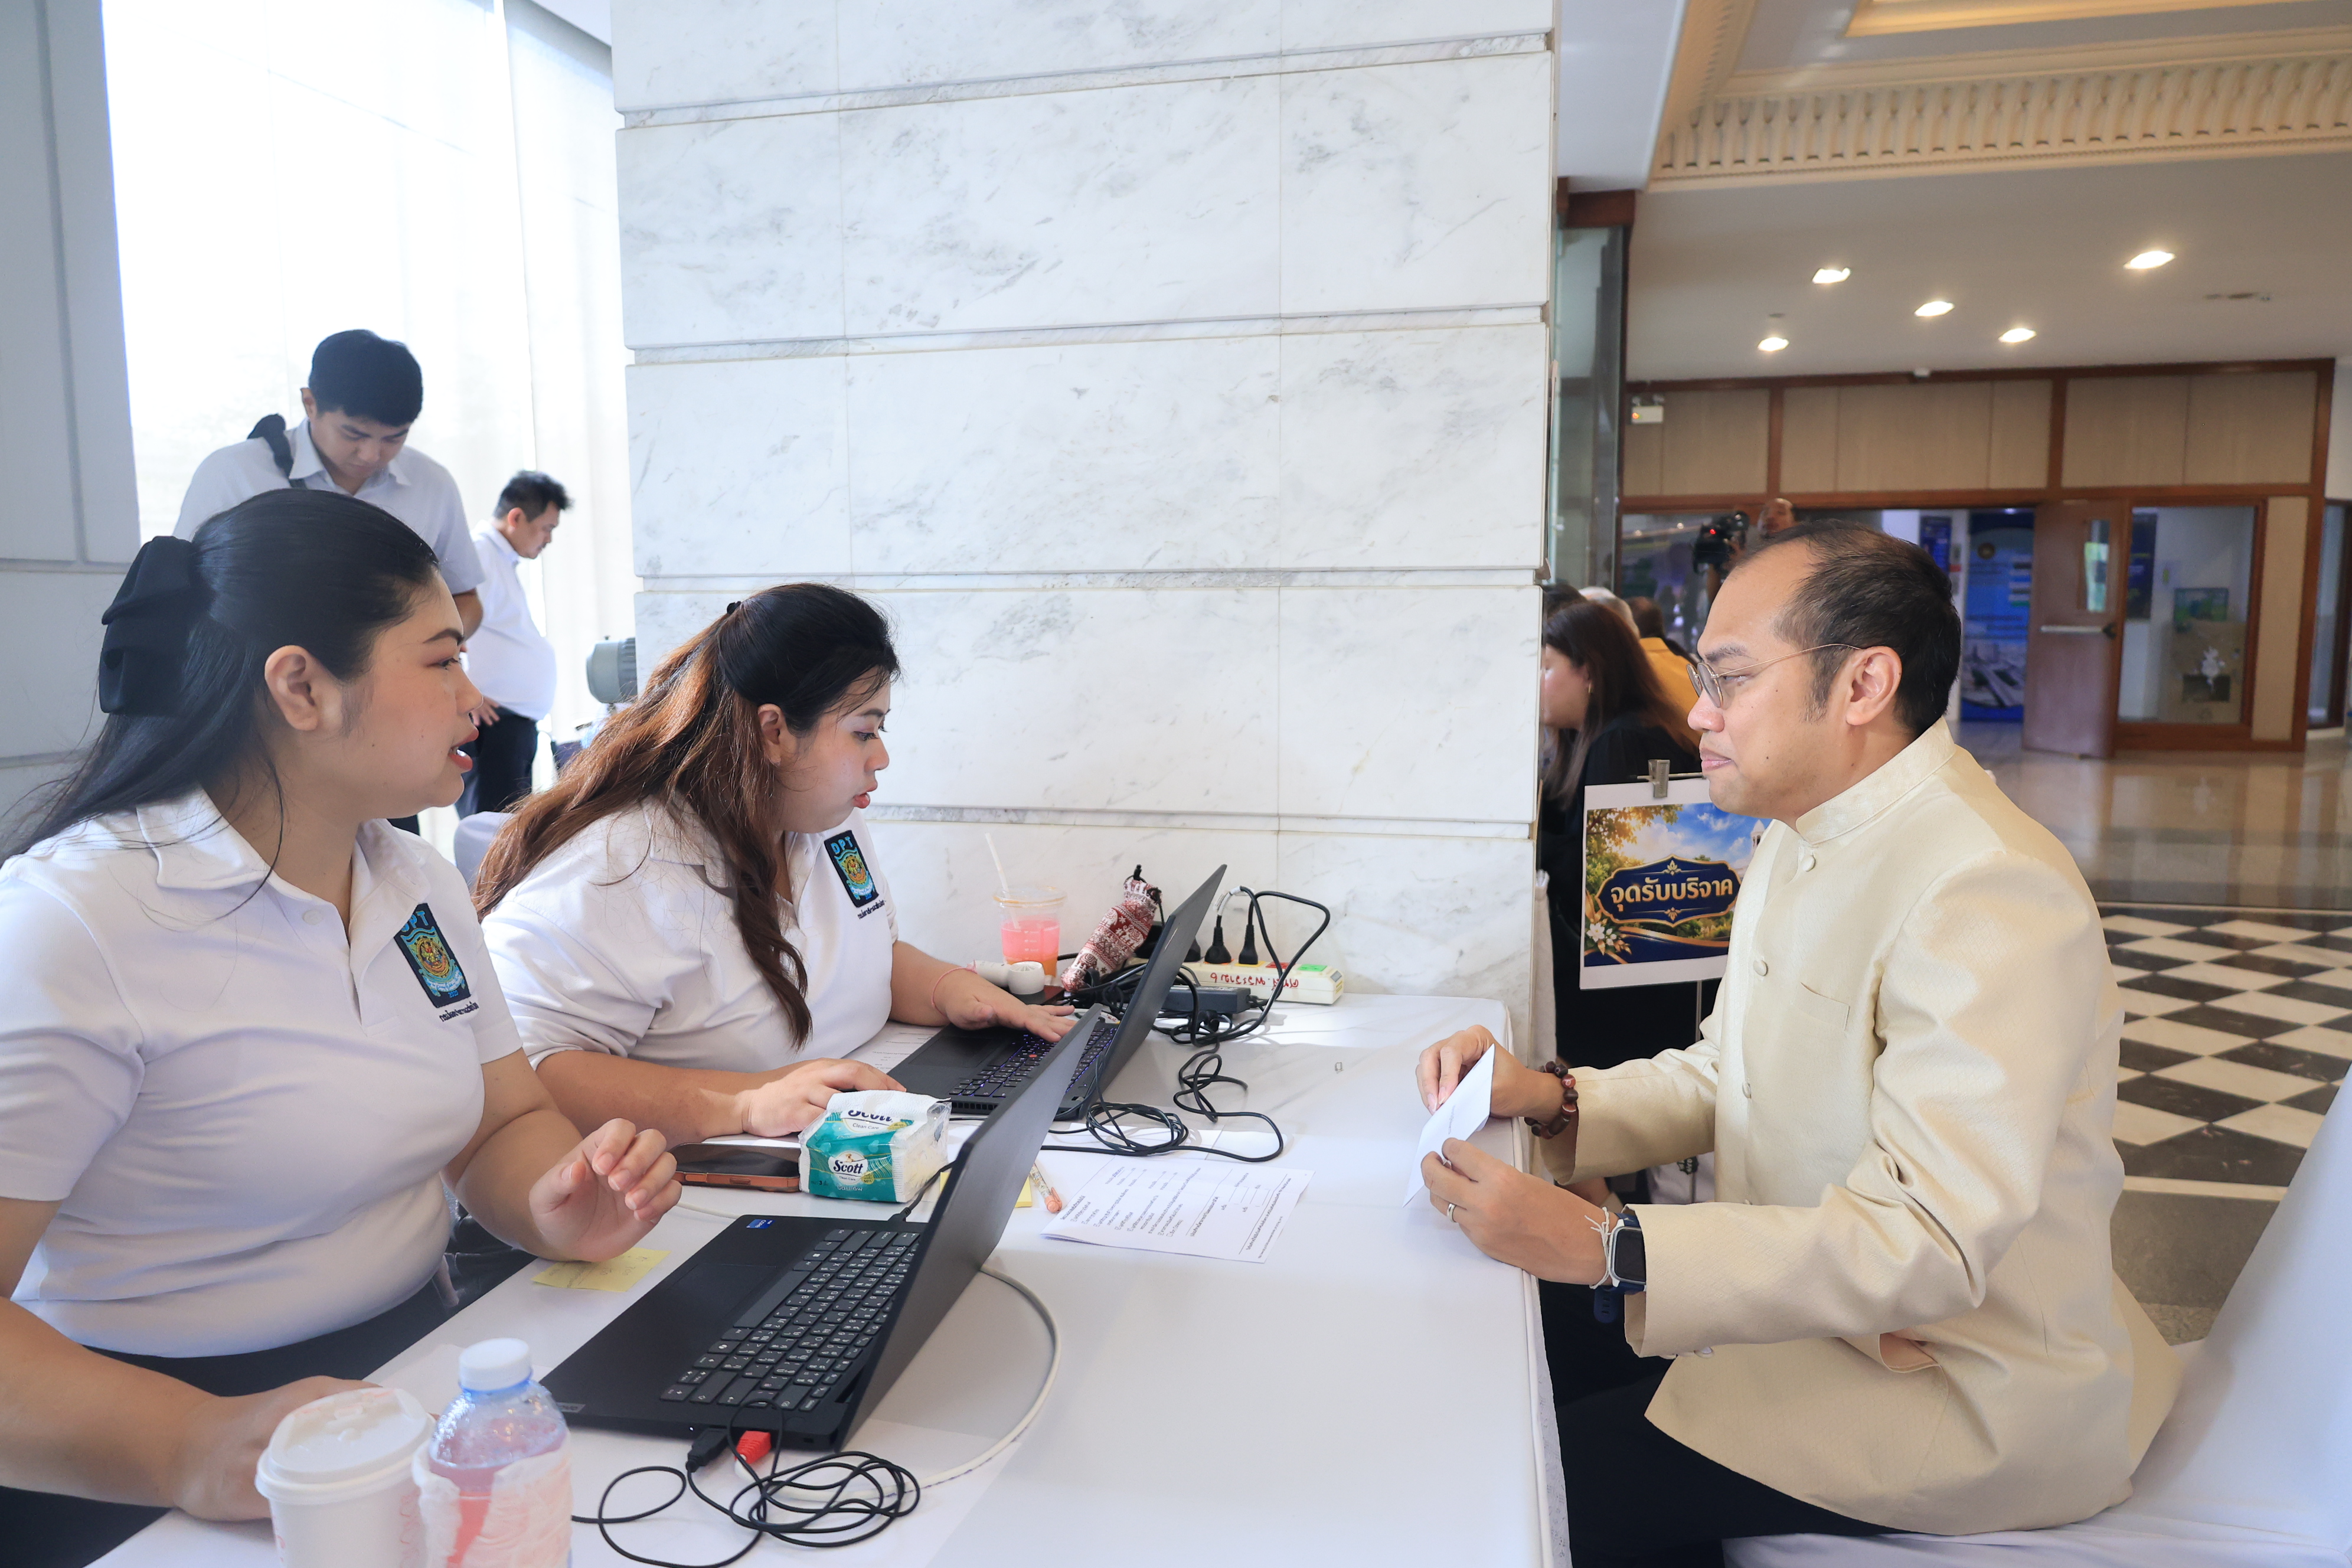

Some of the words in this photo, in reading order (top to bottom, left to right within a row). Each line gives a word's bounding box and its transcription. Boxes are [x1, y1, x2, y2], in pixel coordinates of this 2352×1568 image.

[831, 836, 853, 854] DPT
[1611, 876, 1733, 912] จุดรับบริจาค
[833, 1160, 863, 1174] Scott
